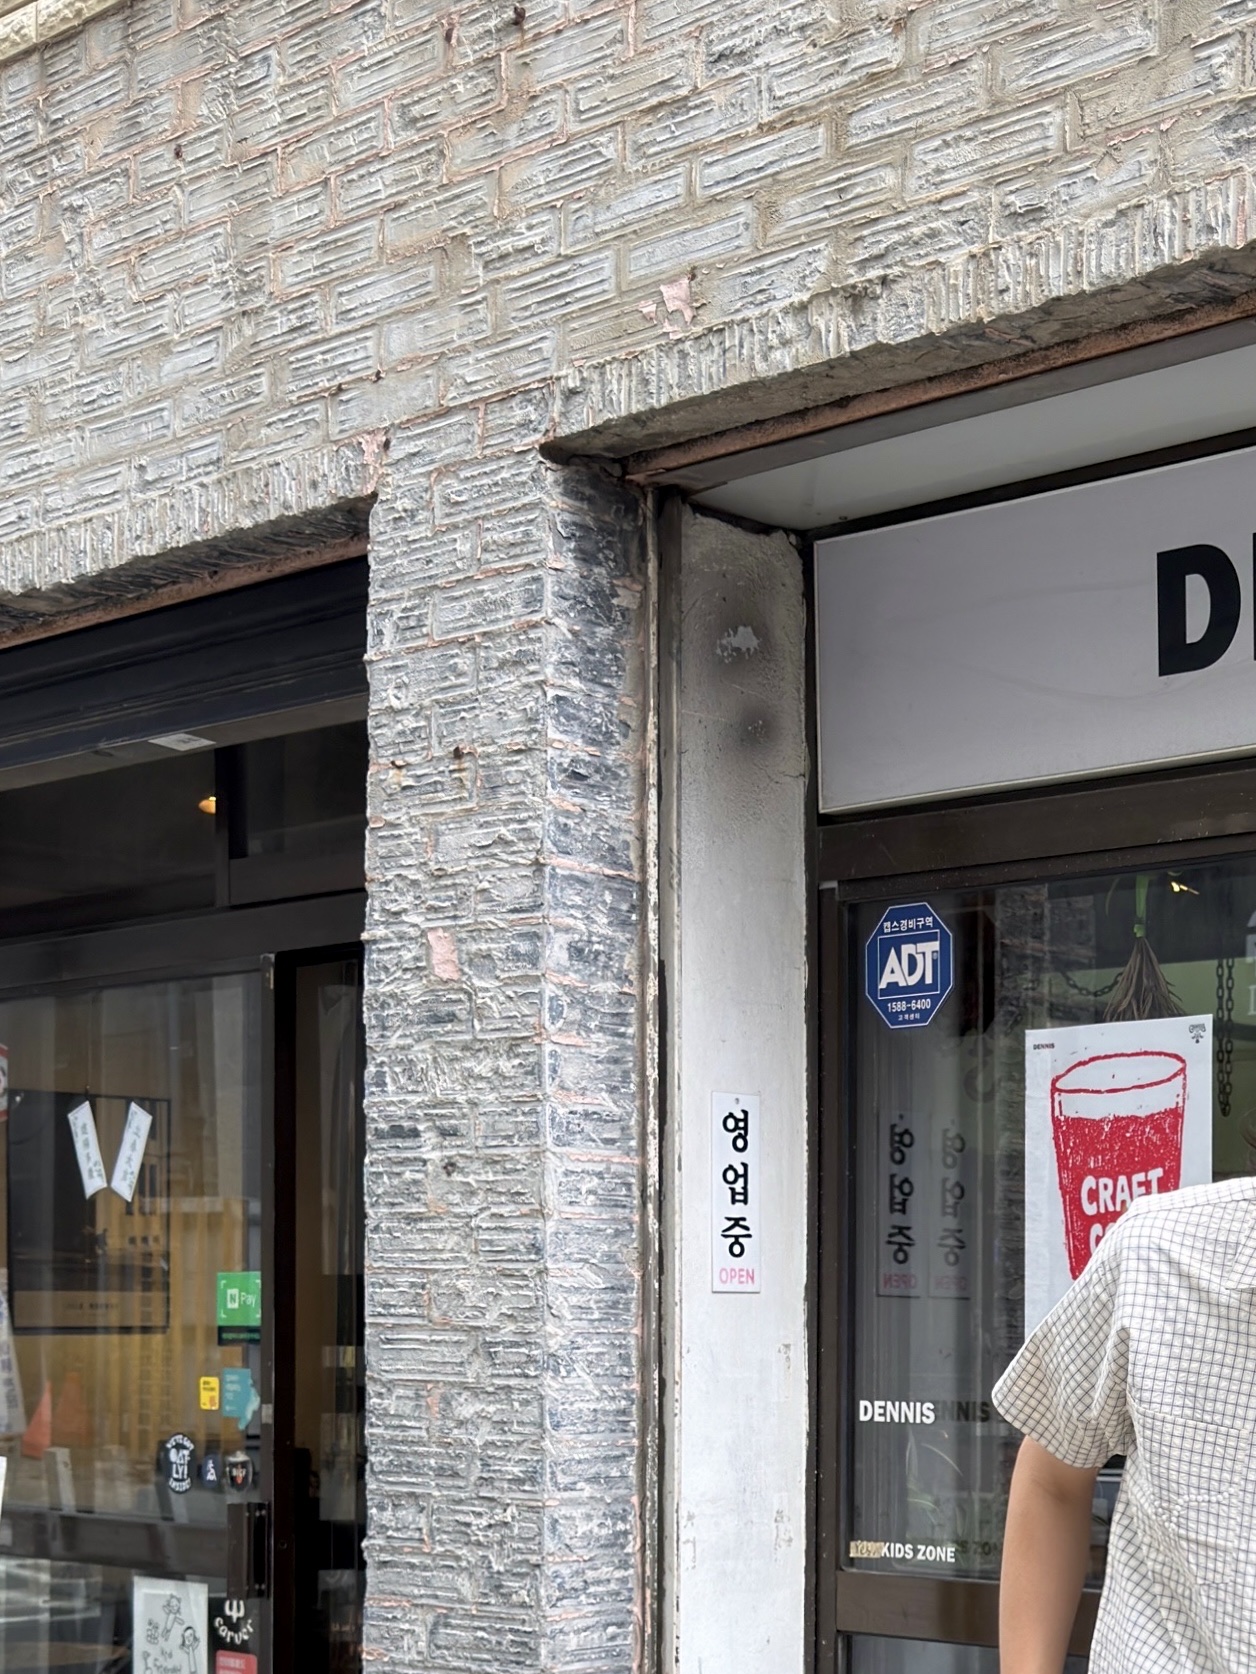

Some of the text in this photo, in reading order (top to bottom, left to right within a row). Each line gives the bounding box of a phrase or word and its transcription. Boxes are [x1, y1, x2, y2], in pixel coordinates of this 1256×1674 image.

[879, 941, 940, 989] ADT
[887, 999, 932, 1013] 1588-6400
[721, 1109, 753, 1258] 영업중
[1080, 1167, 1164, 1217] CRAFT
[719, 1267, 755, 1285] OPEN
[859, 1400, 936, 1425] DENNIS
[881, 1542, 914, 1560] KIDS
[916, 1544, 956, 1563] ZONE
